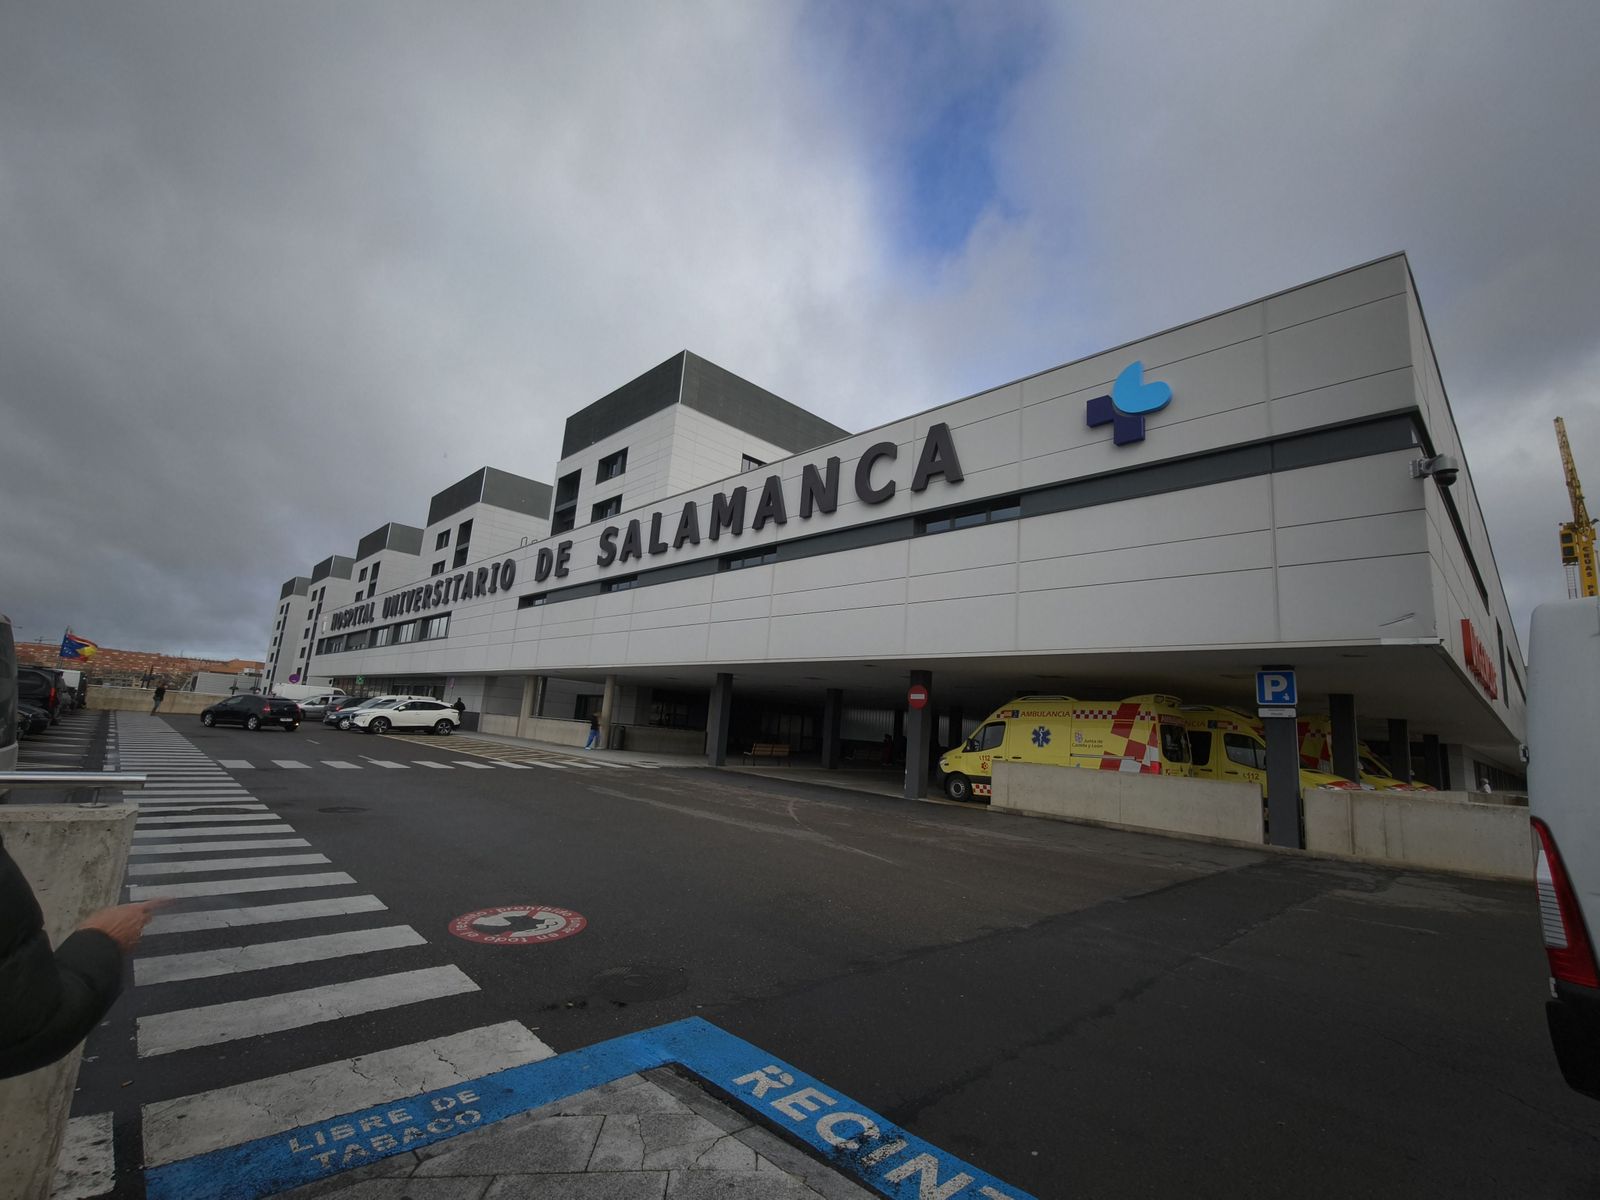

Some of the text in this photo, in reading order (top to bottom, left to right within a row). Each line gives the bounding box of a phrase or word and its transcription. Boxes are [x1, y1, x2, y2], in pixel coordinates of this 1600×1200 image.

[330, 422, 965, 631] HOSPITAL UNIVERSITARIO DE SALAMANCA
[1263, 674, 1288, 701] P
[1021, 710, 1071, 718] AMBULANCIA
[484, 935, 527, 943] todo
[537, 932, 558, 941] en
[288, 1090, 481, 1154] LIBRE DE
[310, 1110, 482, 1169] TABACO
